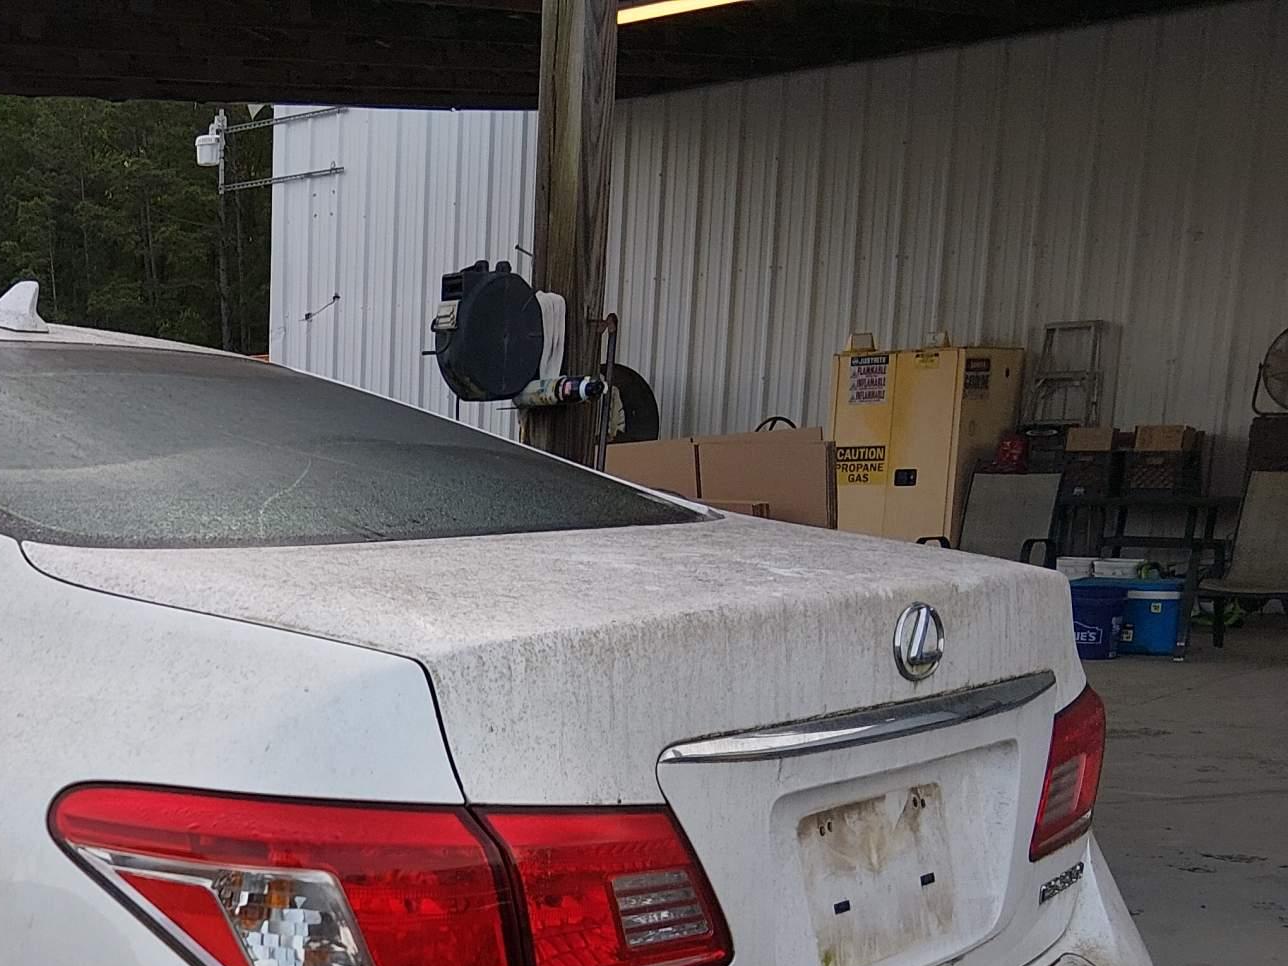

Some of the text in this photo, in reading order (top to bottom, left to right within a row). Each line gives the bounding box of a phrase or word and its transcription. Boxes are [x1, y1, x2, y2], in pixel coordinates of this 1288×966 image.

[836, 447, 884, 460] CAUTION
[834, 463, 885, 472] PROPANE
[848, 473, 869, 482] GAS
